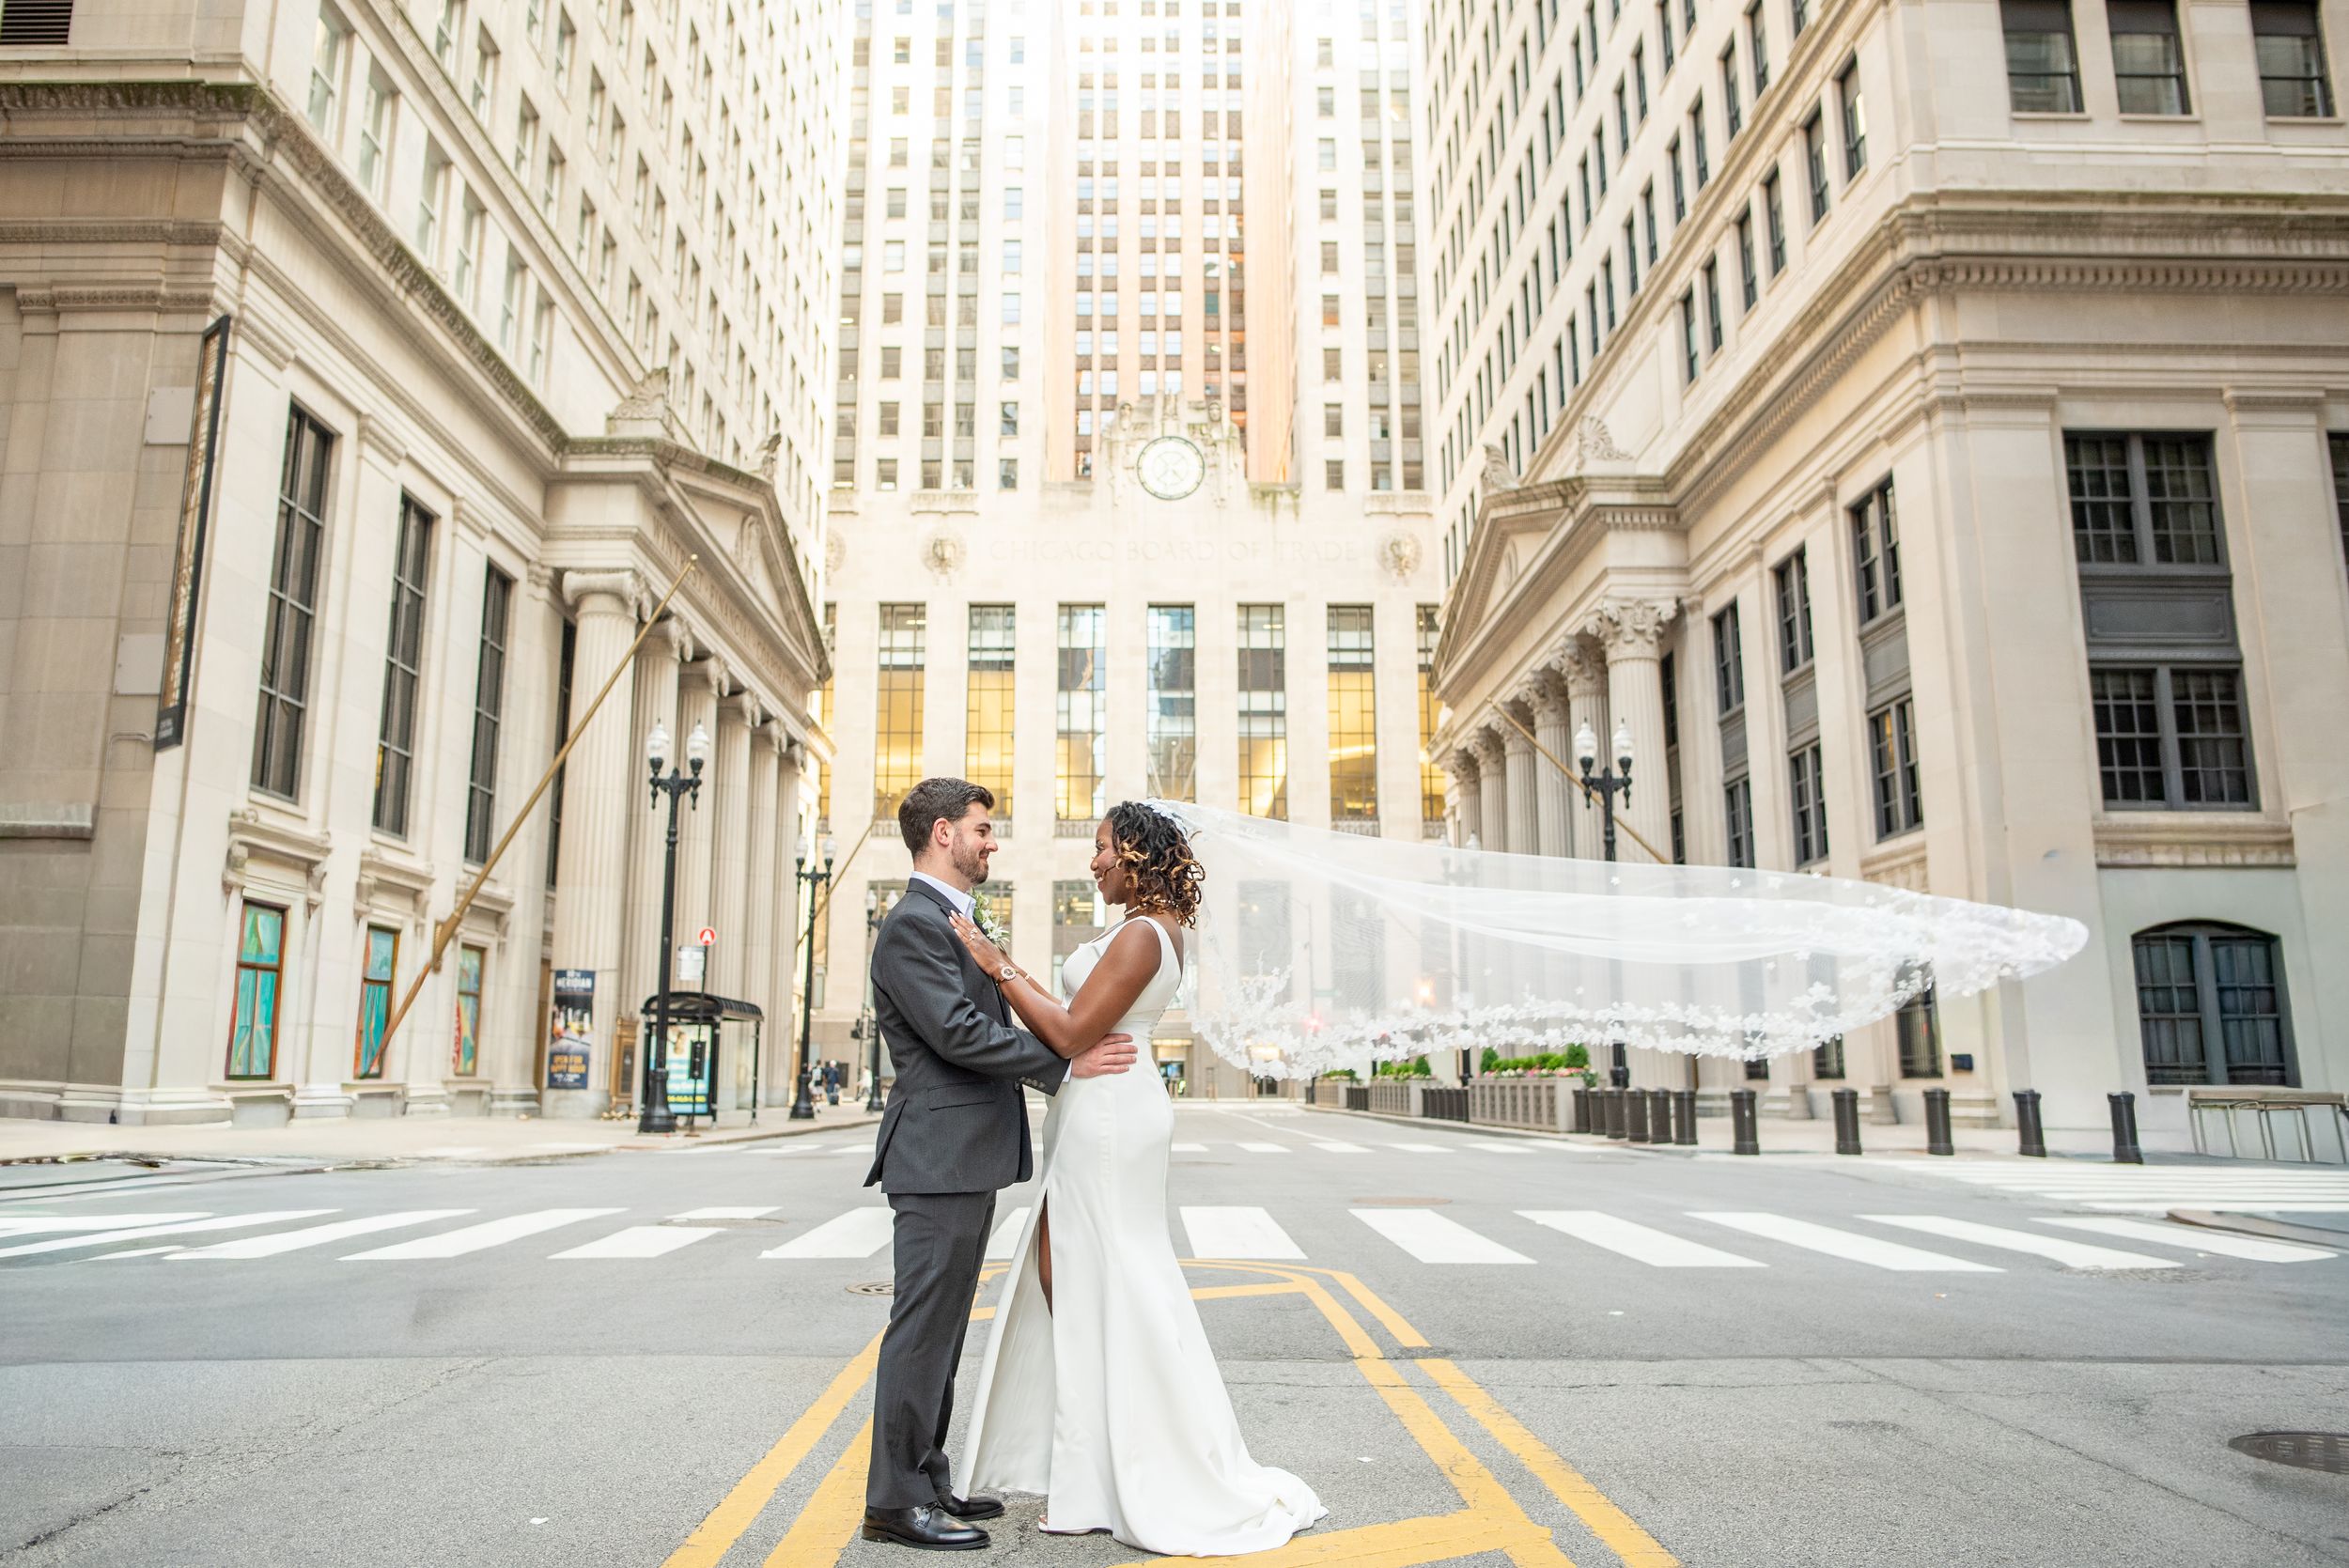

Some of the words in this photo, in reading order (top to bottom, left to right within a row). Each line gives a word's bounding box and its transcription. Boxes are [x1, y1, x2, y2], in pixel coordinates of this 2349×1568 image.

[989, 540, 1115, 563] CHICAGO
[1128, 540, 1215, 563] BOARD
[1228, 540, 1262, 563] OF
[1276, 540, 1357, 563] TRADE
